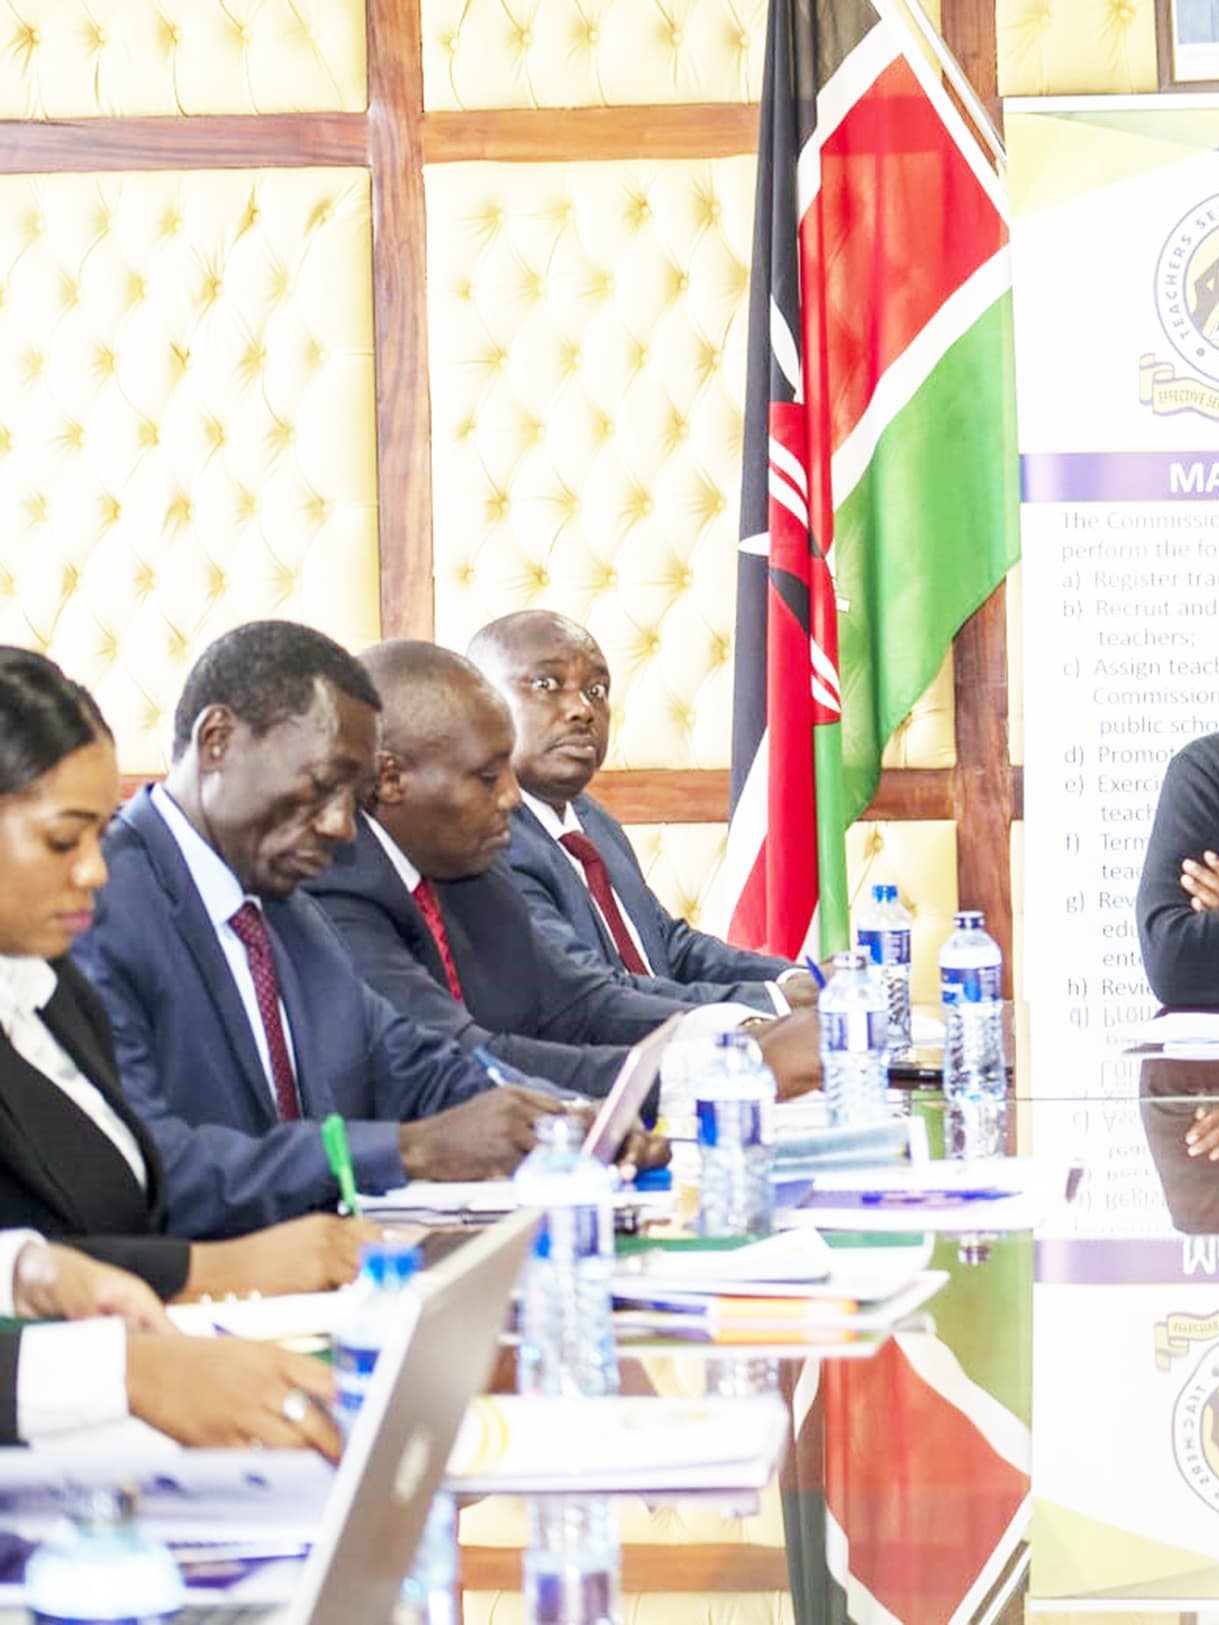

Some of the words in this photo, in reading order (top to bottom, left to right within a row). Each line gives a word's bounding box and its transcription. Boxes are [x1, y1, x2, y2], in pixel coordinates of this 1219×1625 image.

[1164, 234, 1193, 340] TEACHERS
[1157, 388, 1204, 405] EFFECTIVE
[1062, 511, 1099, 529] The
[1061, 539, 1148, 563] perform
[1155, 539, 1191, 558] the
[1061, 570, 1081, 590] a)
[1094, 570, 1178, 592] Register
[1063, 599, 1083, 621] b)
[1096, 599, 1170, 617] Recruit
[1177, 598, 1217, 617] and
[1063, 656, 1081, 679] c)
[1093, 657, 1161, 680] Assign
[1098, 714, 1164, 738] public
[1063, 745, 1085, 767] d)
[1098, 745, 1175, 764] Promot
[1064, 774, 1085, 797] e)
[1098, 774, 1160, 793] Exerci
[1065, 832, 1080, 856] f)
[1065, 888, 1085, 913] g)
[1099, 891, 1137, 909] Rev
[1067, 977, 1088, 999] h)
